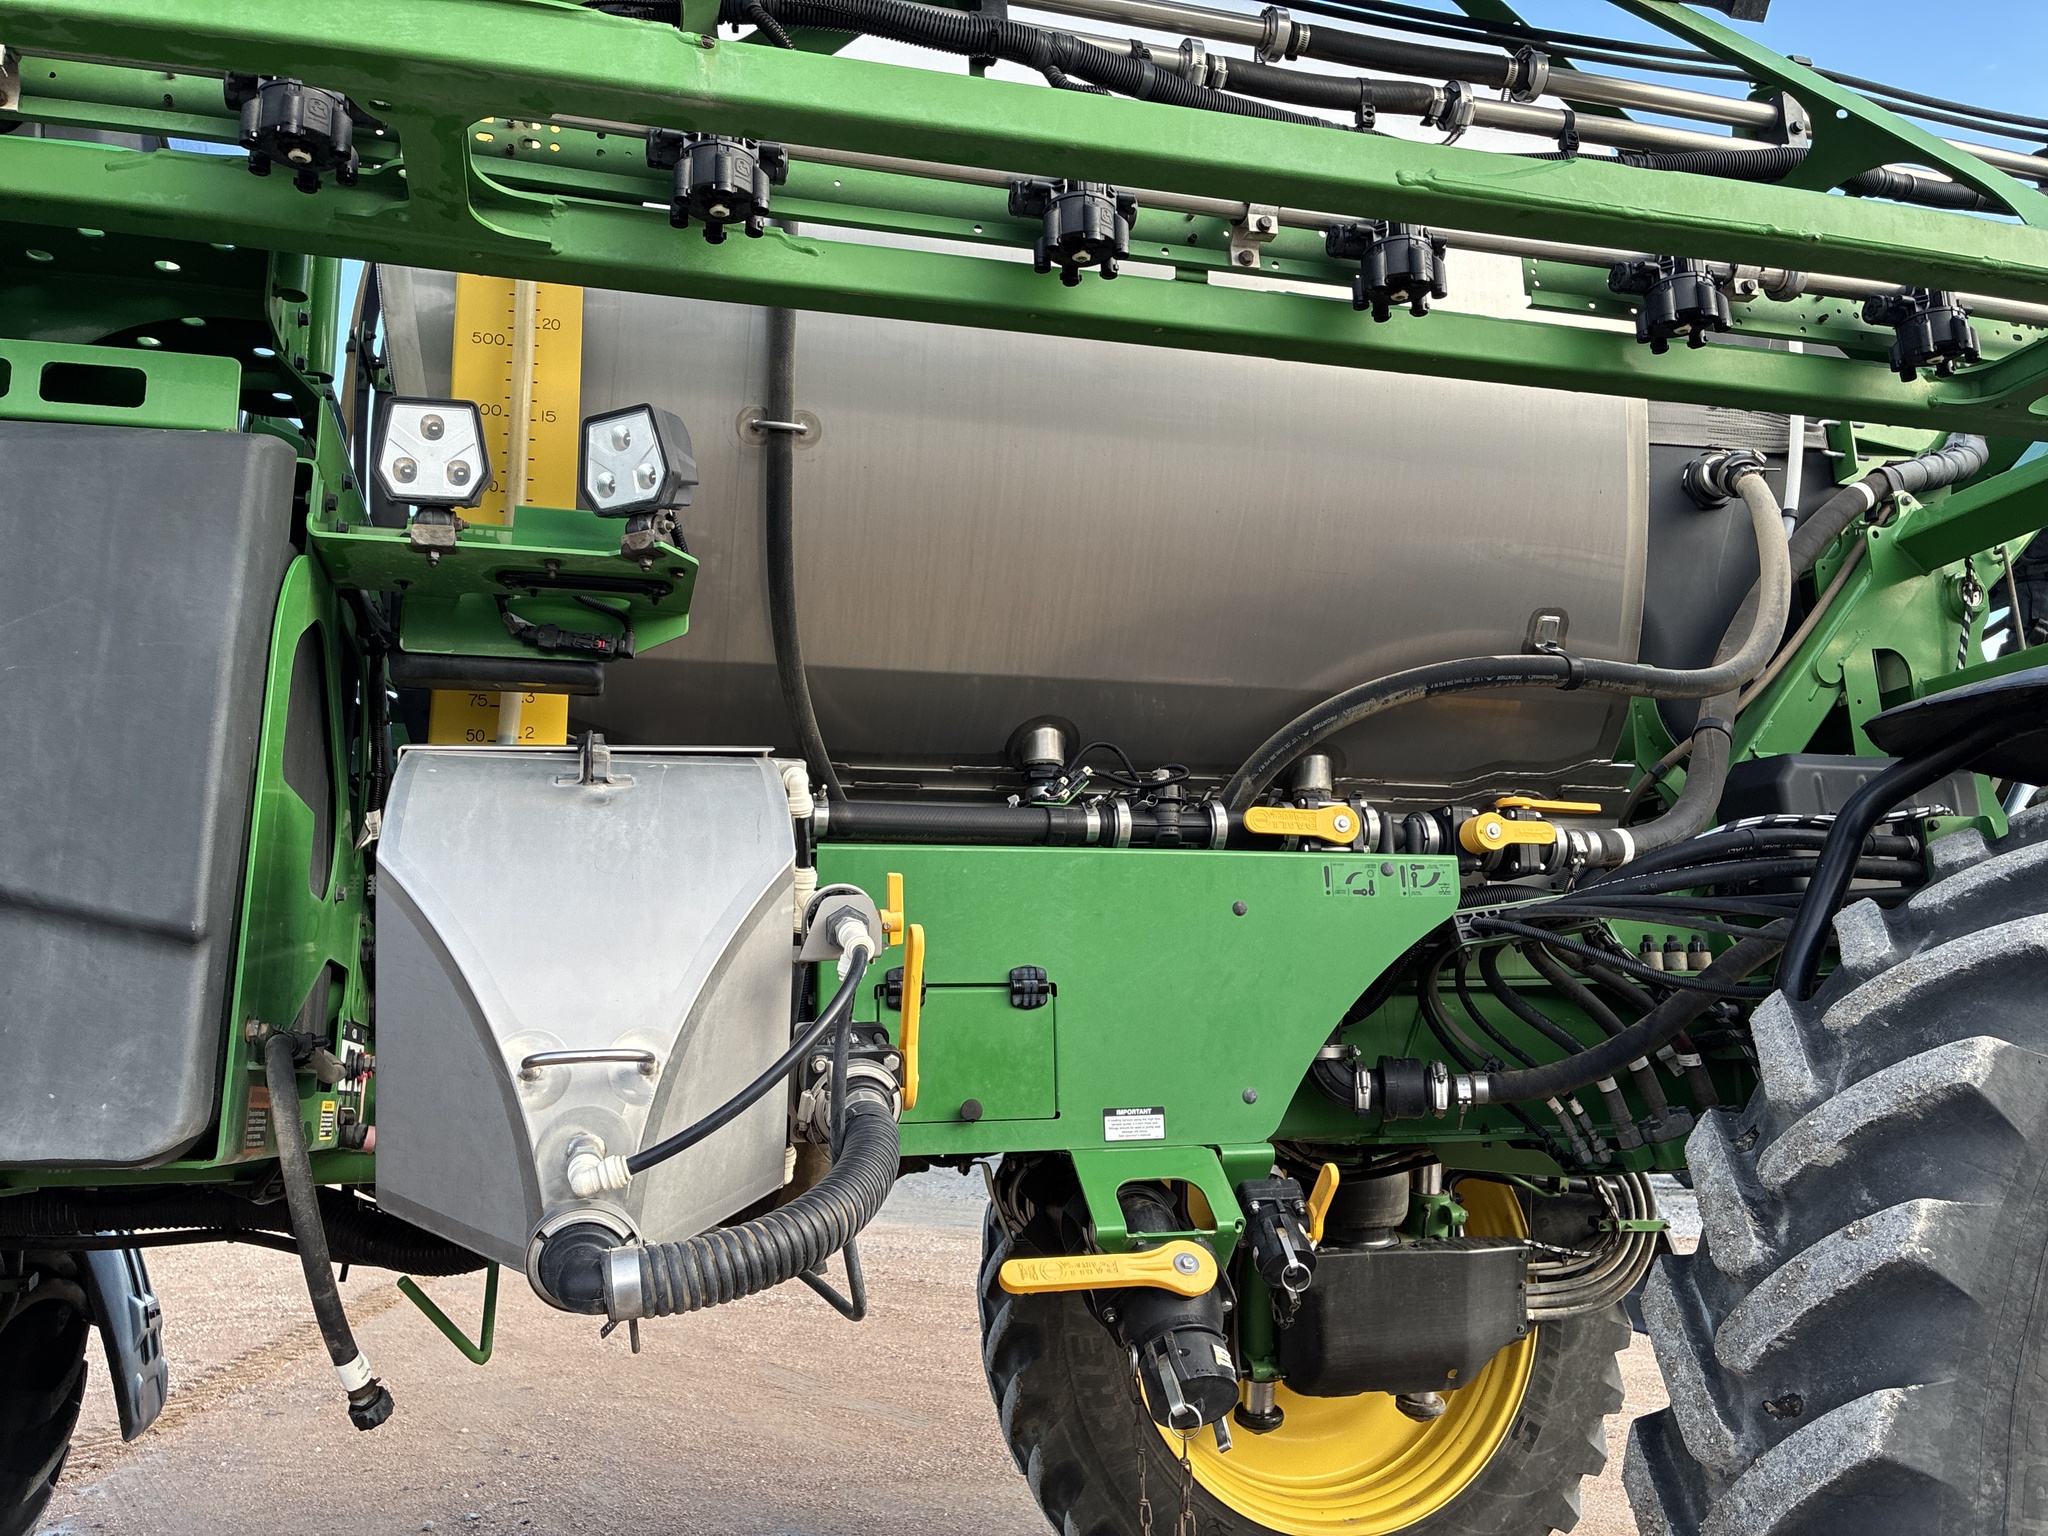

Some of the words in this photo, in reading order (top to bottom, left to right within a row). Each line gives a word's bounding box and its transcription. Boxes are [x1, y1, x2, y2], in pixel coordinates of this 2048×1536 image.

[542, 318, 561, 331] 20
[471, 331, 505, 346] 500
[480, 404, 502, 416] 00
[541, 410, 557, 423] 15
[468, 693, 488, 707] 75
[466, 729, 485, 743] 50
[1116, 1108, 1152, 1116] IMPORTANT
